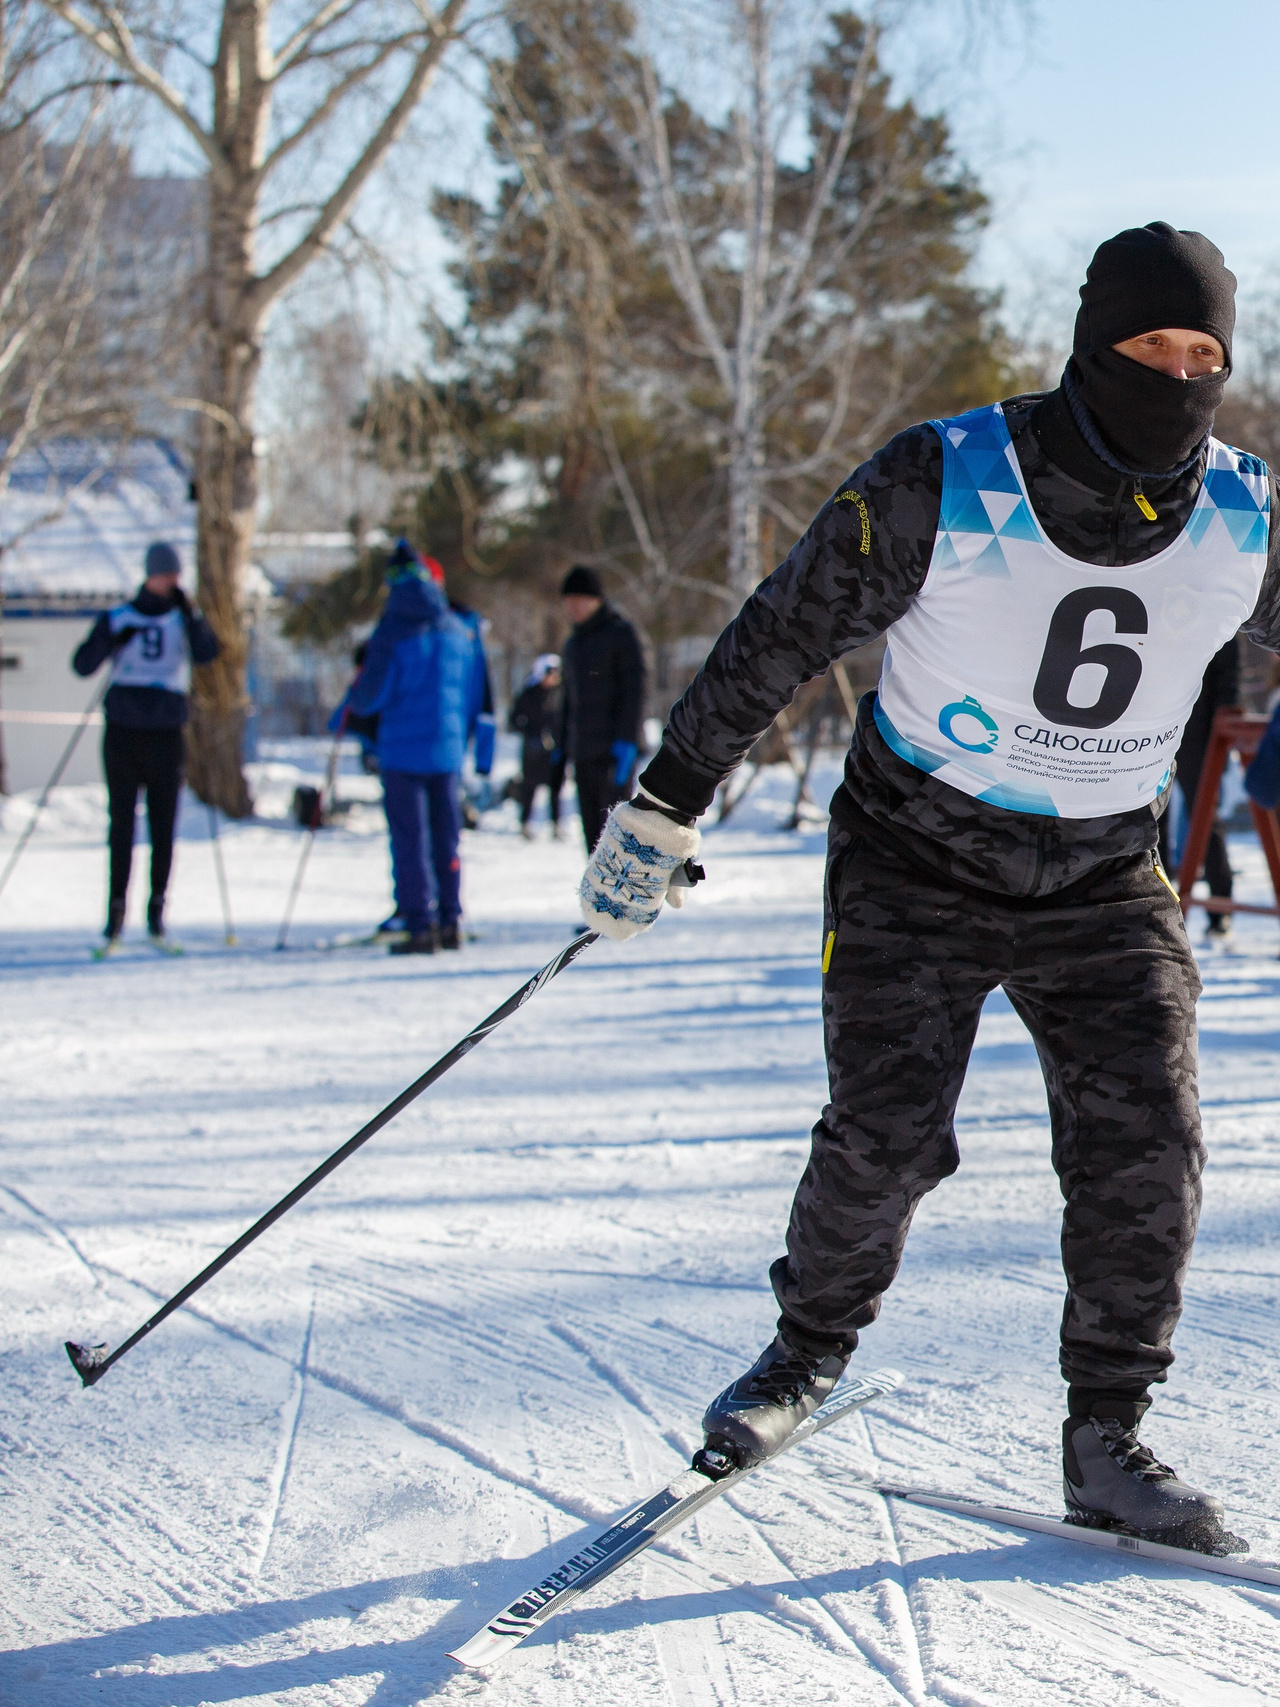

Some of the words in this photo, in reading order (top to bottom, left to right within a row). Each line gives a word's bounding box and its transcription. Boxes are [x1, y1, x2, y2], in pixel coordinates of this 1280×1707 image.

[1032, 585, 1149, 730] 6
[1014, 724, 1151, 753] СДЮСШОР
[1153, 725, 1179, 749] №2
[1007, 753, 1099, 775] детско-юношеская
[1011, 744, 1112, 767] Специализированная
[1006, 762, 1074, 782] олимпийского
[1074, 776, 1110, 785] резерва
[521, 1543, 608, 1610] UNIVERSAL
